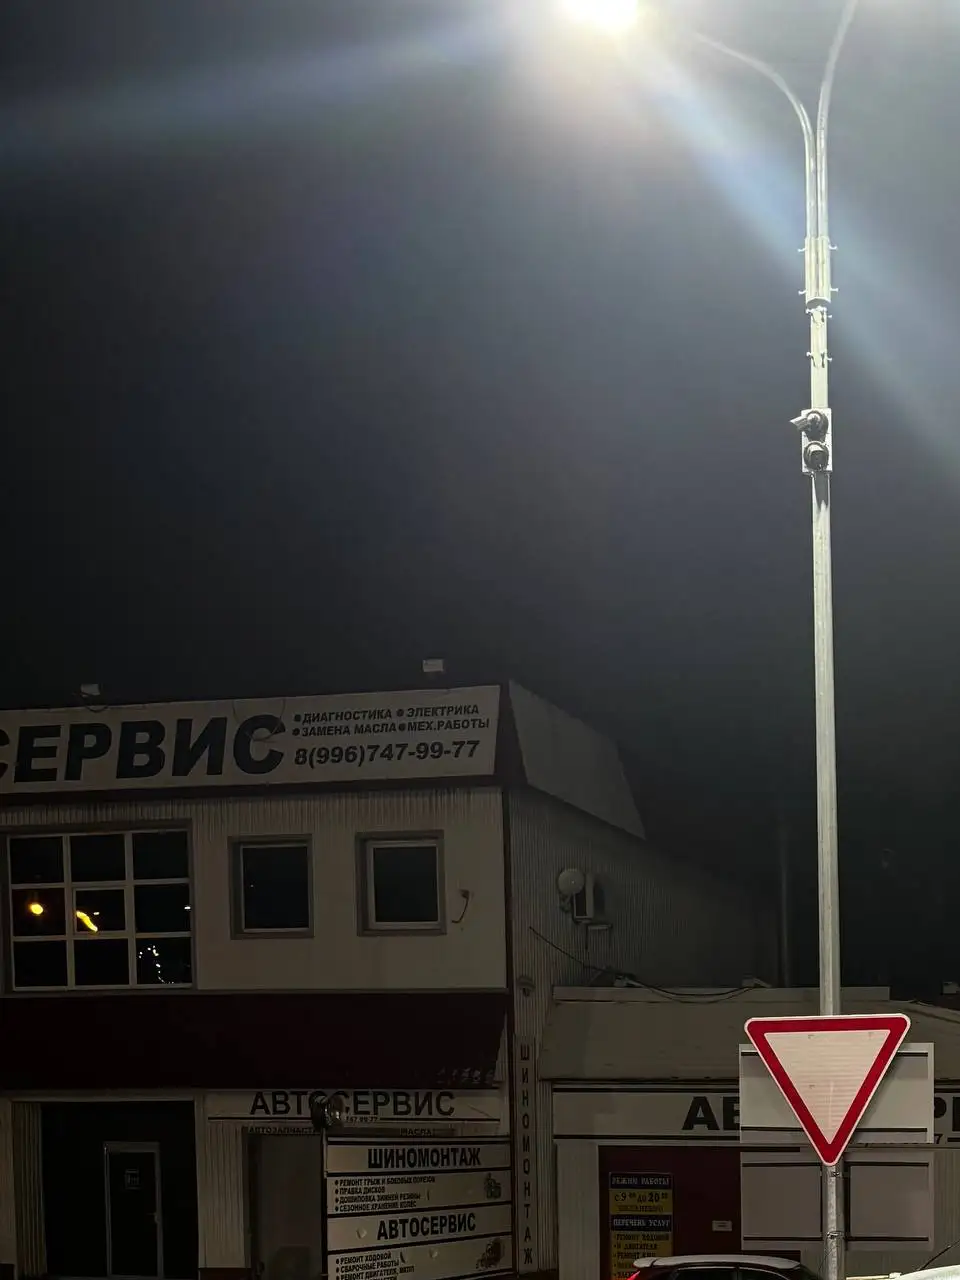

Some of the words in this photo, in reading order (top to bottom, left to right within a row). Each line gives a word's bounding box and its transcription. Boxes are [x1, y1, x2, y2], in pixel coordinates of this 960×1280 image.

[302, 709, 392, 725] ДИАГНОСТИКА
[406, 704, 479, 718] ЭЛЕКТРИКА
[302, 724, 351, 737] ЗАМЕНА
[353, 722, 397, 735] МАСЛА
[0, 714, 286, 784] ЕРВИС
[294, 740, 480, 769] 8(996)747-99-77
[367, 1147, 481, 1168] ШИНОМОНТАЖ
[520, 1044, 533, 1265] ШИНОМОНТАЖ
[648, 1192, 660, 1202] 20
[377, 1212, 476, 1240] АВТОСЕРВИС
[340, 1256, 363, 1265] РЕМОНТ
[340, 1272, 364, 1280] РЕМОНТ
